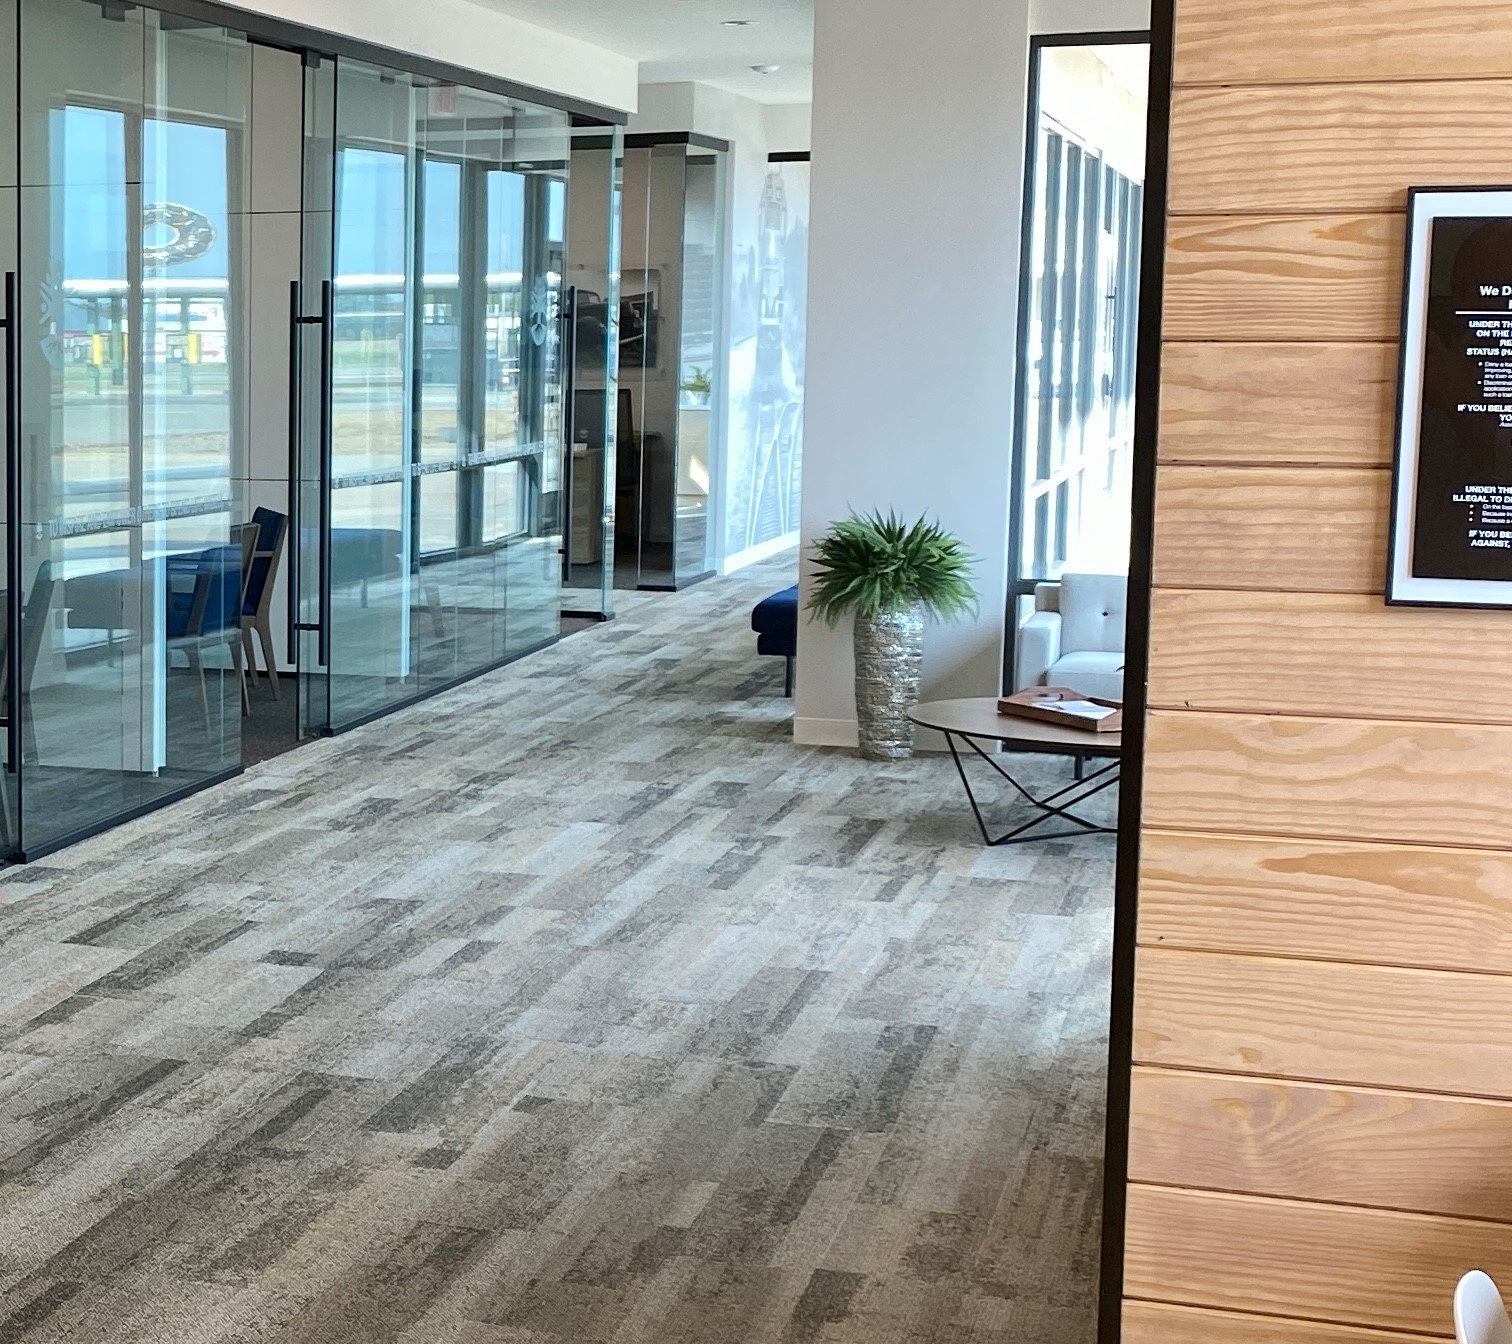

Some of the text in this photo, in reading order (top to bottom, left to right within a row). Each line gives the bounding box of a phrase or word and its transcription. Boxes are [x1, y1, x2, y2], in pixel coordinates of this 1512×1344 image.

[1479, 285, 1512, 296] We D
[1468, 320, 1500, 328] UNDER
[1466, 347, 1500, 355] STATUS
[1467, 404, 1486, 412] YOU
[1452, 494, 1489, 502] ILLEGAL
[1490, 495, 1503, 503] TO
[1478, 530, 1498, 538] YOU
[1470, 539, 1511, 548] AGAINST,
